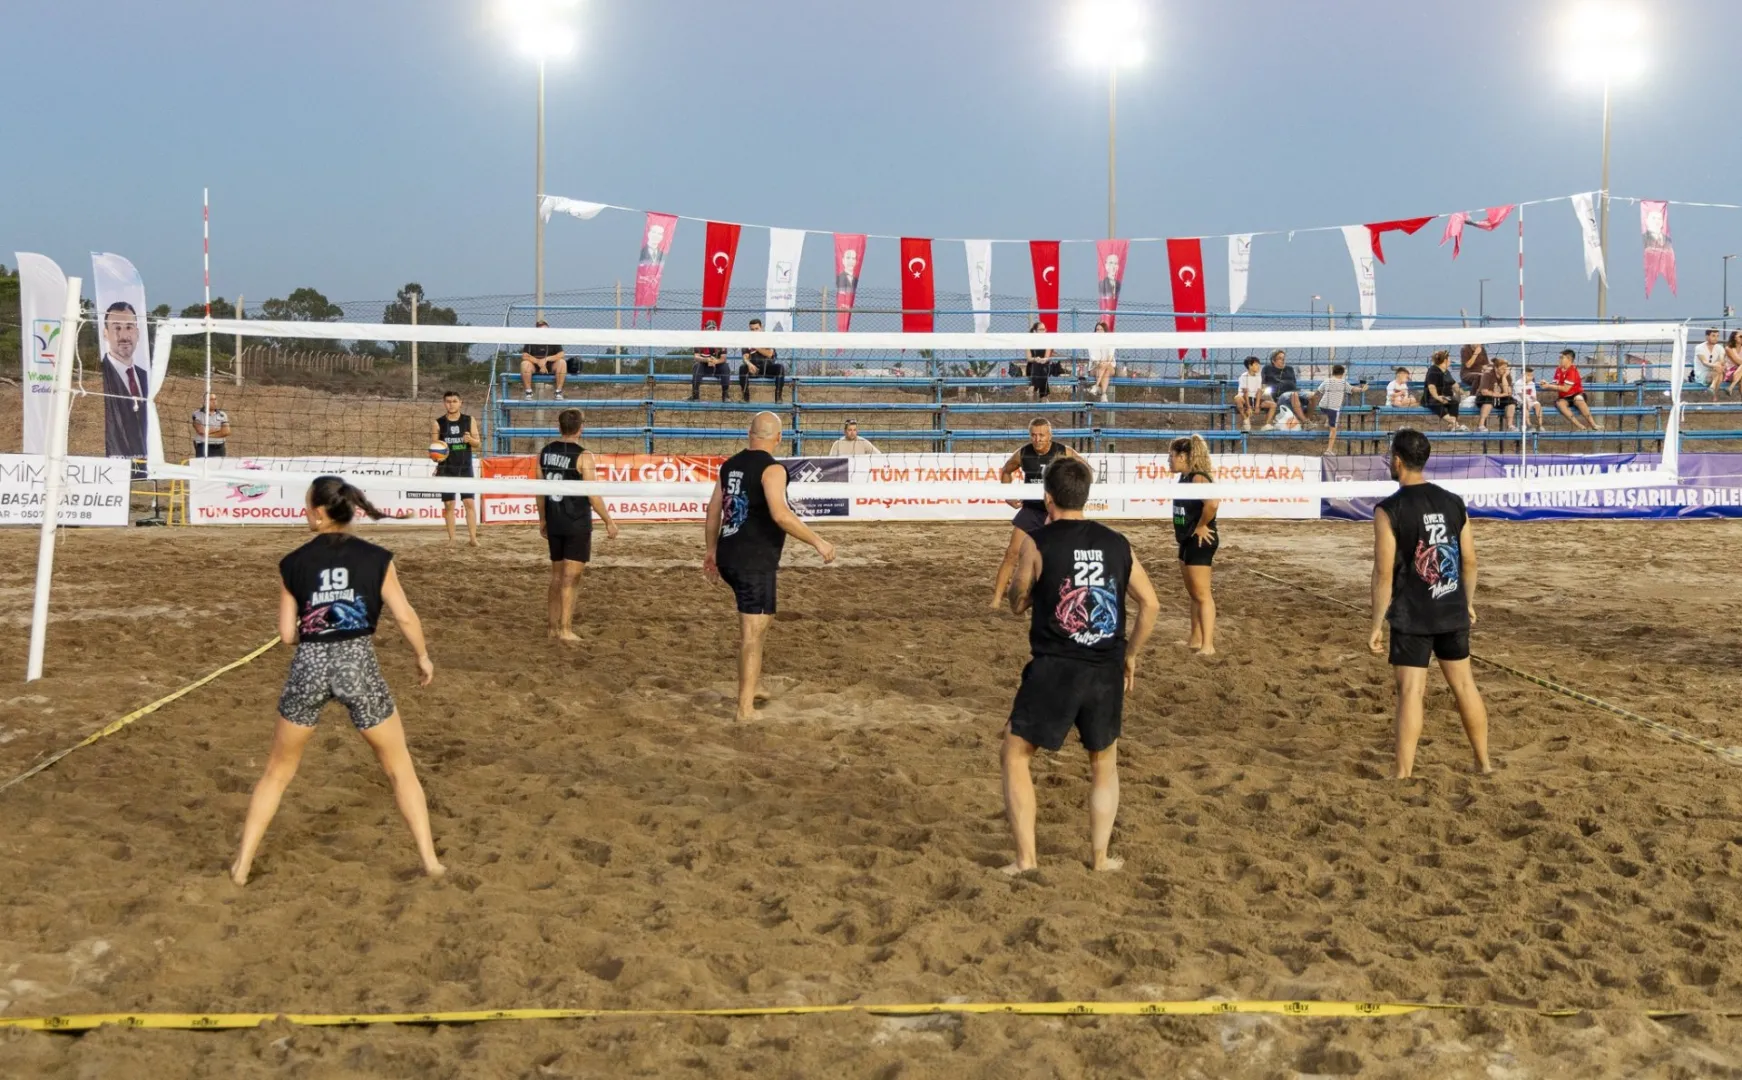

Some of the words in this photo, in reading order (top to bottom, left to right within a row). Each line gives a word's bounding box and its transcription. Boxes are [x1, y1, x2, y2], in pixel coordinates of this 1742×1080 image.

[0, 460, 113, 485] MİMRLIK
[639, 457, 698, 484] GÖK
[870, 464, 909, 482] TÜM
[1135, 462, 1175, 480] TÜM
[83, 492, 124, 507] DİLER
[1463, 489, 1600, 507] PORCULARIMIZA
[1603, 487, 1698, 509] BAŞARILAR
[1703, 488, 1742, 506] DİLE
[198, 504, 229, 519] TÜM
[490, 501, 521, 515] TÜM
[620, 502, 699, 515] BAŞARILAR
[1425, 523, 1448, 545] 72
[1073, 549, 1103, 561] ONUR
[320, 567, 349, 591] 19
[1073, 561, 1105, 586] 22
